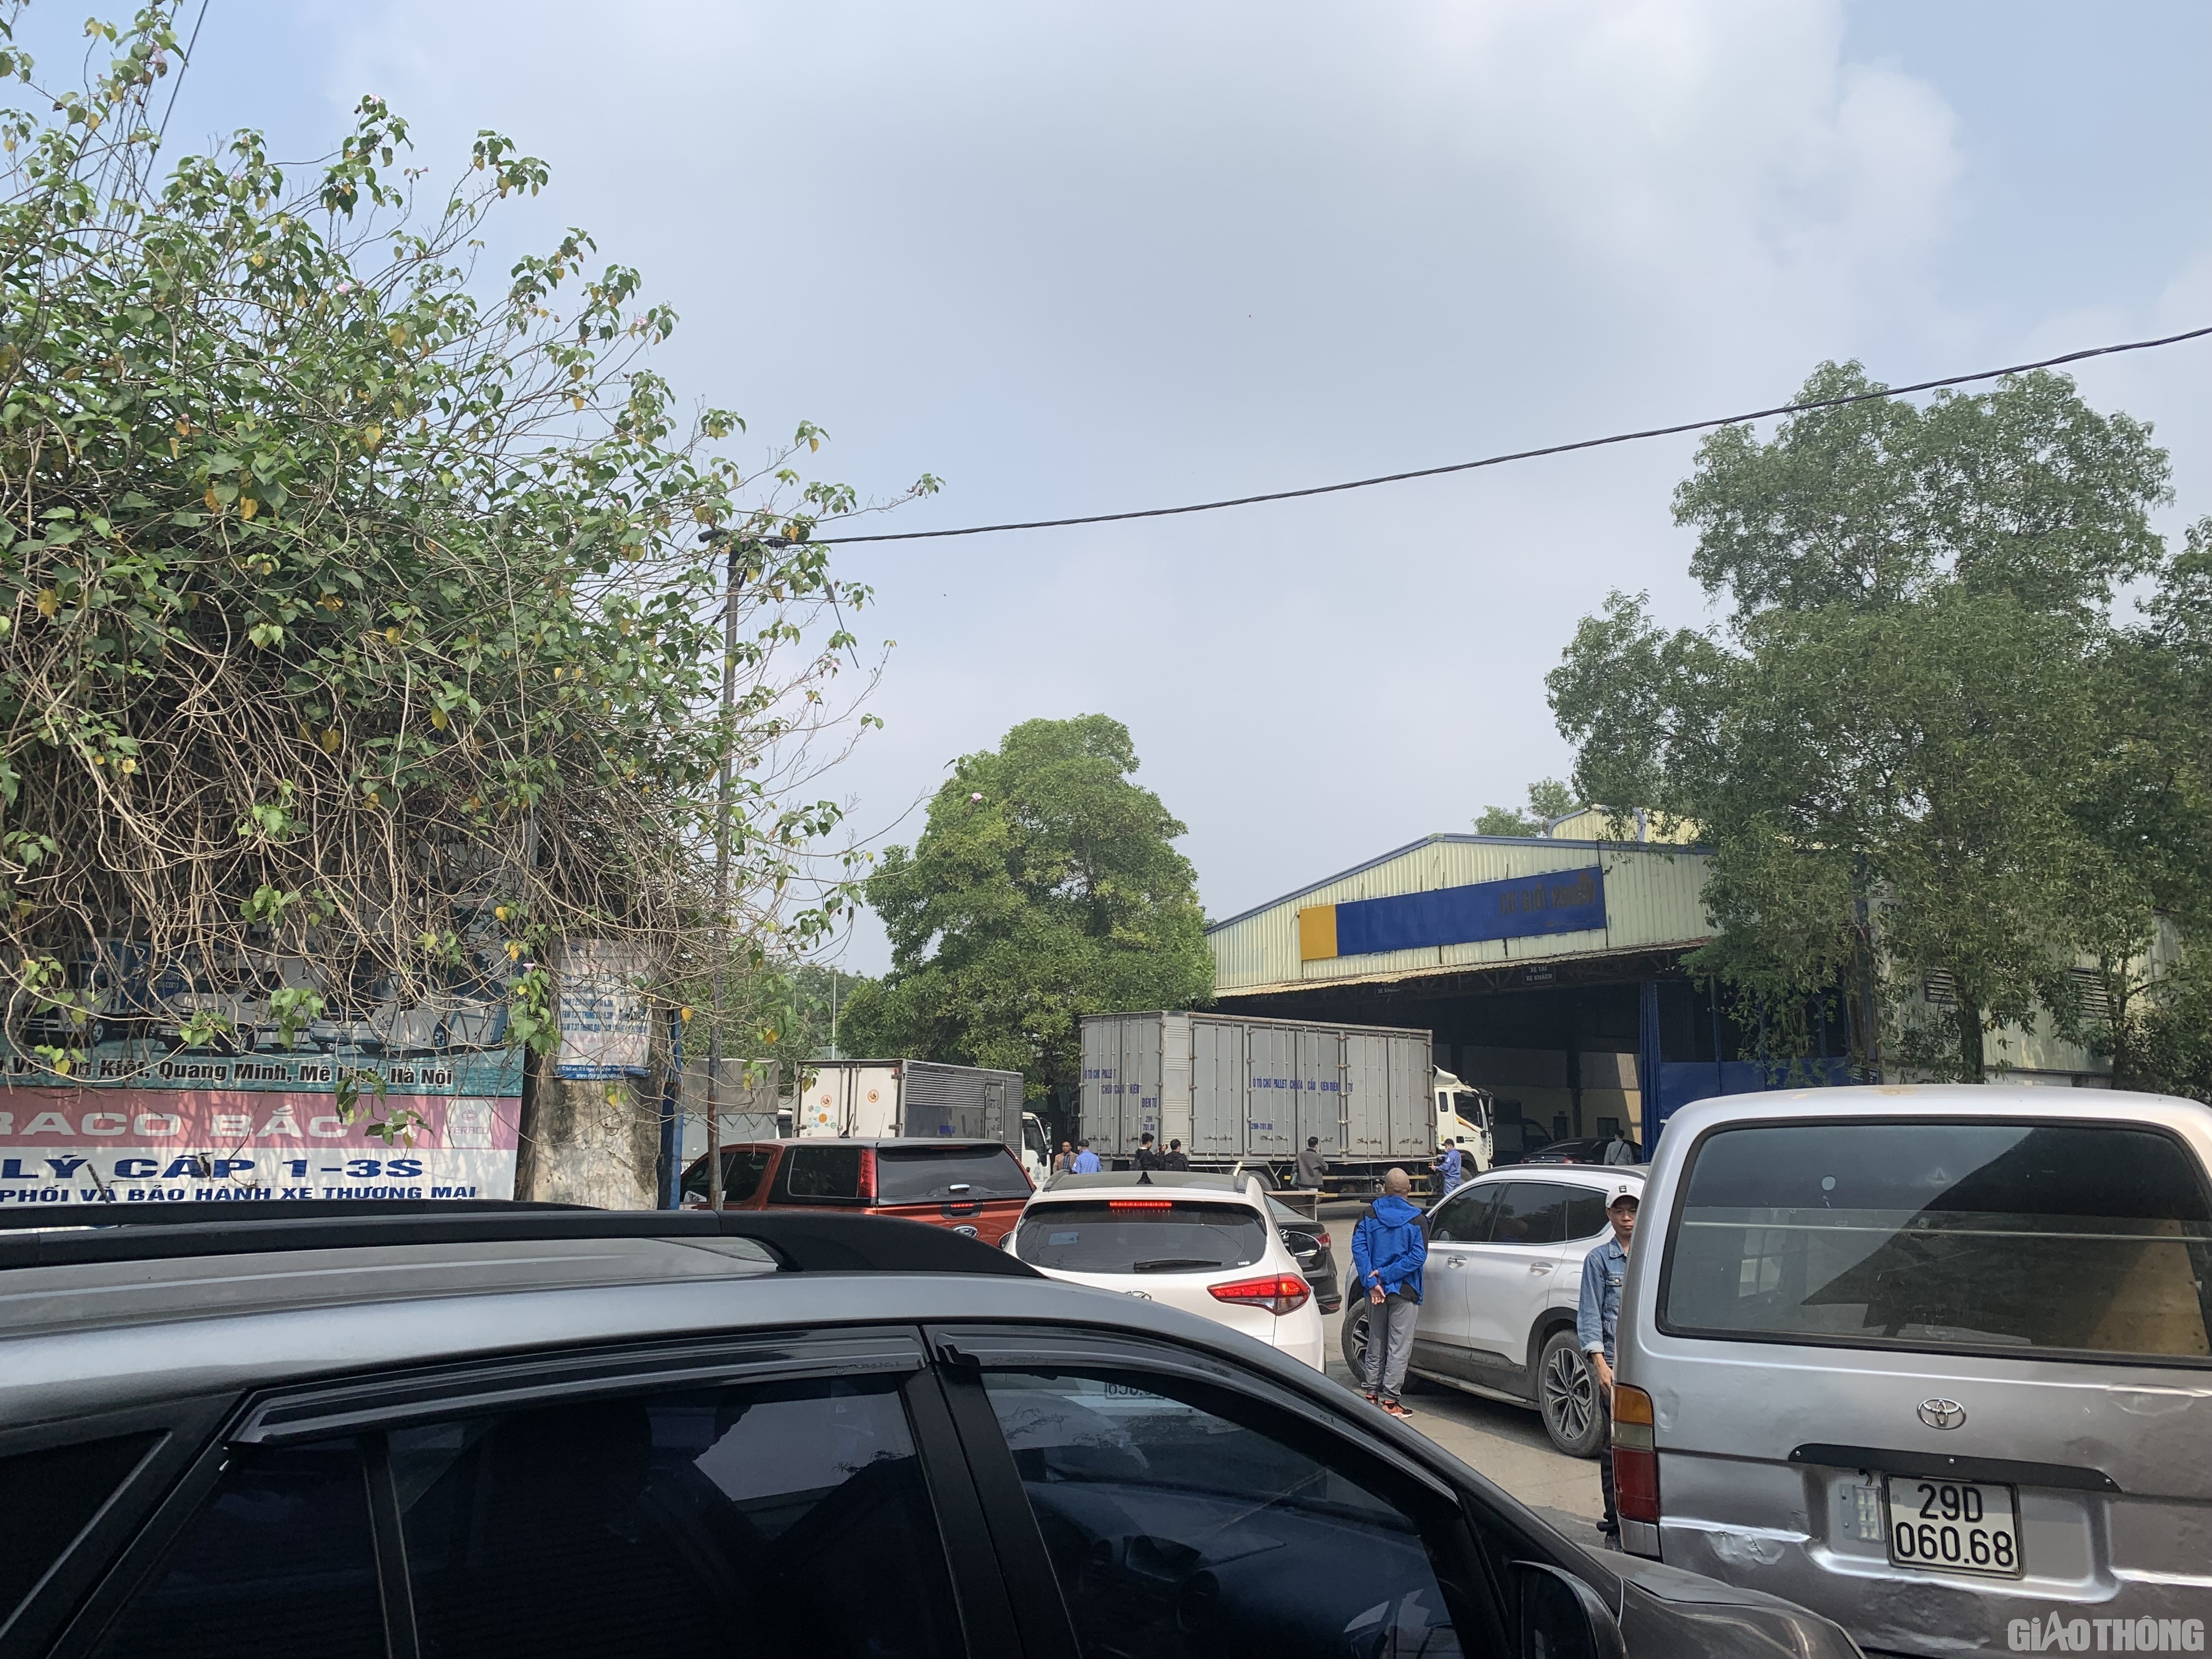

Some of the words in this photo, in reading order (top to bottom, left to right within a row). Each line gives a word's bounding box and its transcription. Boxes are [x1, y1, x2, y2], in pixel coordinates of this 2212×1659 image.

[159, 1061, 227, 1080] Quang
[234, 1063, 291, 1083] Minh,
[300, 1065, 330, 1081] Mê
[421, 1067, 453, 1087] Nội
[1273, 1079, 1287, 1088] PALLET
[210, 1105, 348, 1138] BẮC
[448, 1125, 490, 1135] TERACO
[1, 1154, 88, 1178] LÝ
[114, 1152, 255, 1178] CẤP
[128, 1184, 185, 1202] BẢO
[281, 1187, 313, 1199] XE
[323, 1185, 422, 1199] THƯƠNG
[1917, 1483, 1983, 1523] 29D
[1895, 1521, 2015, 1568] 060.68
